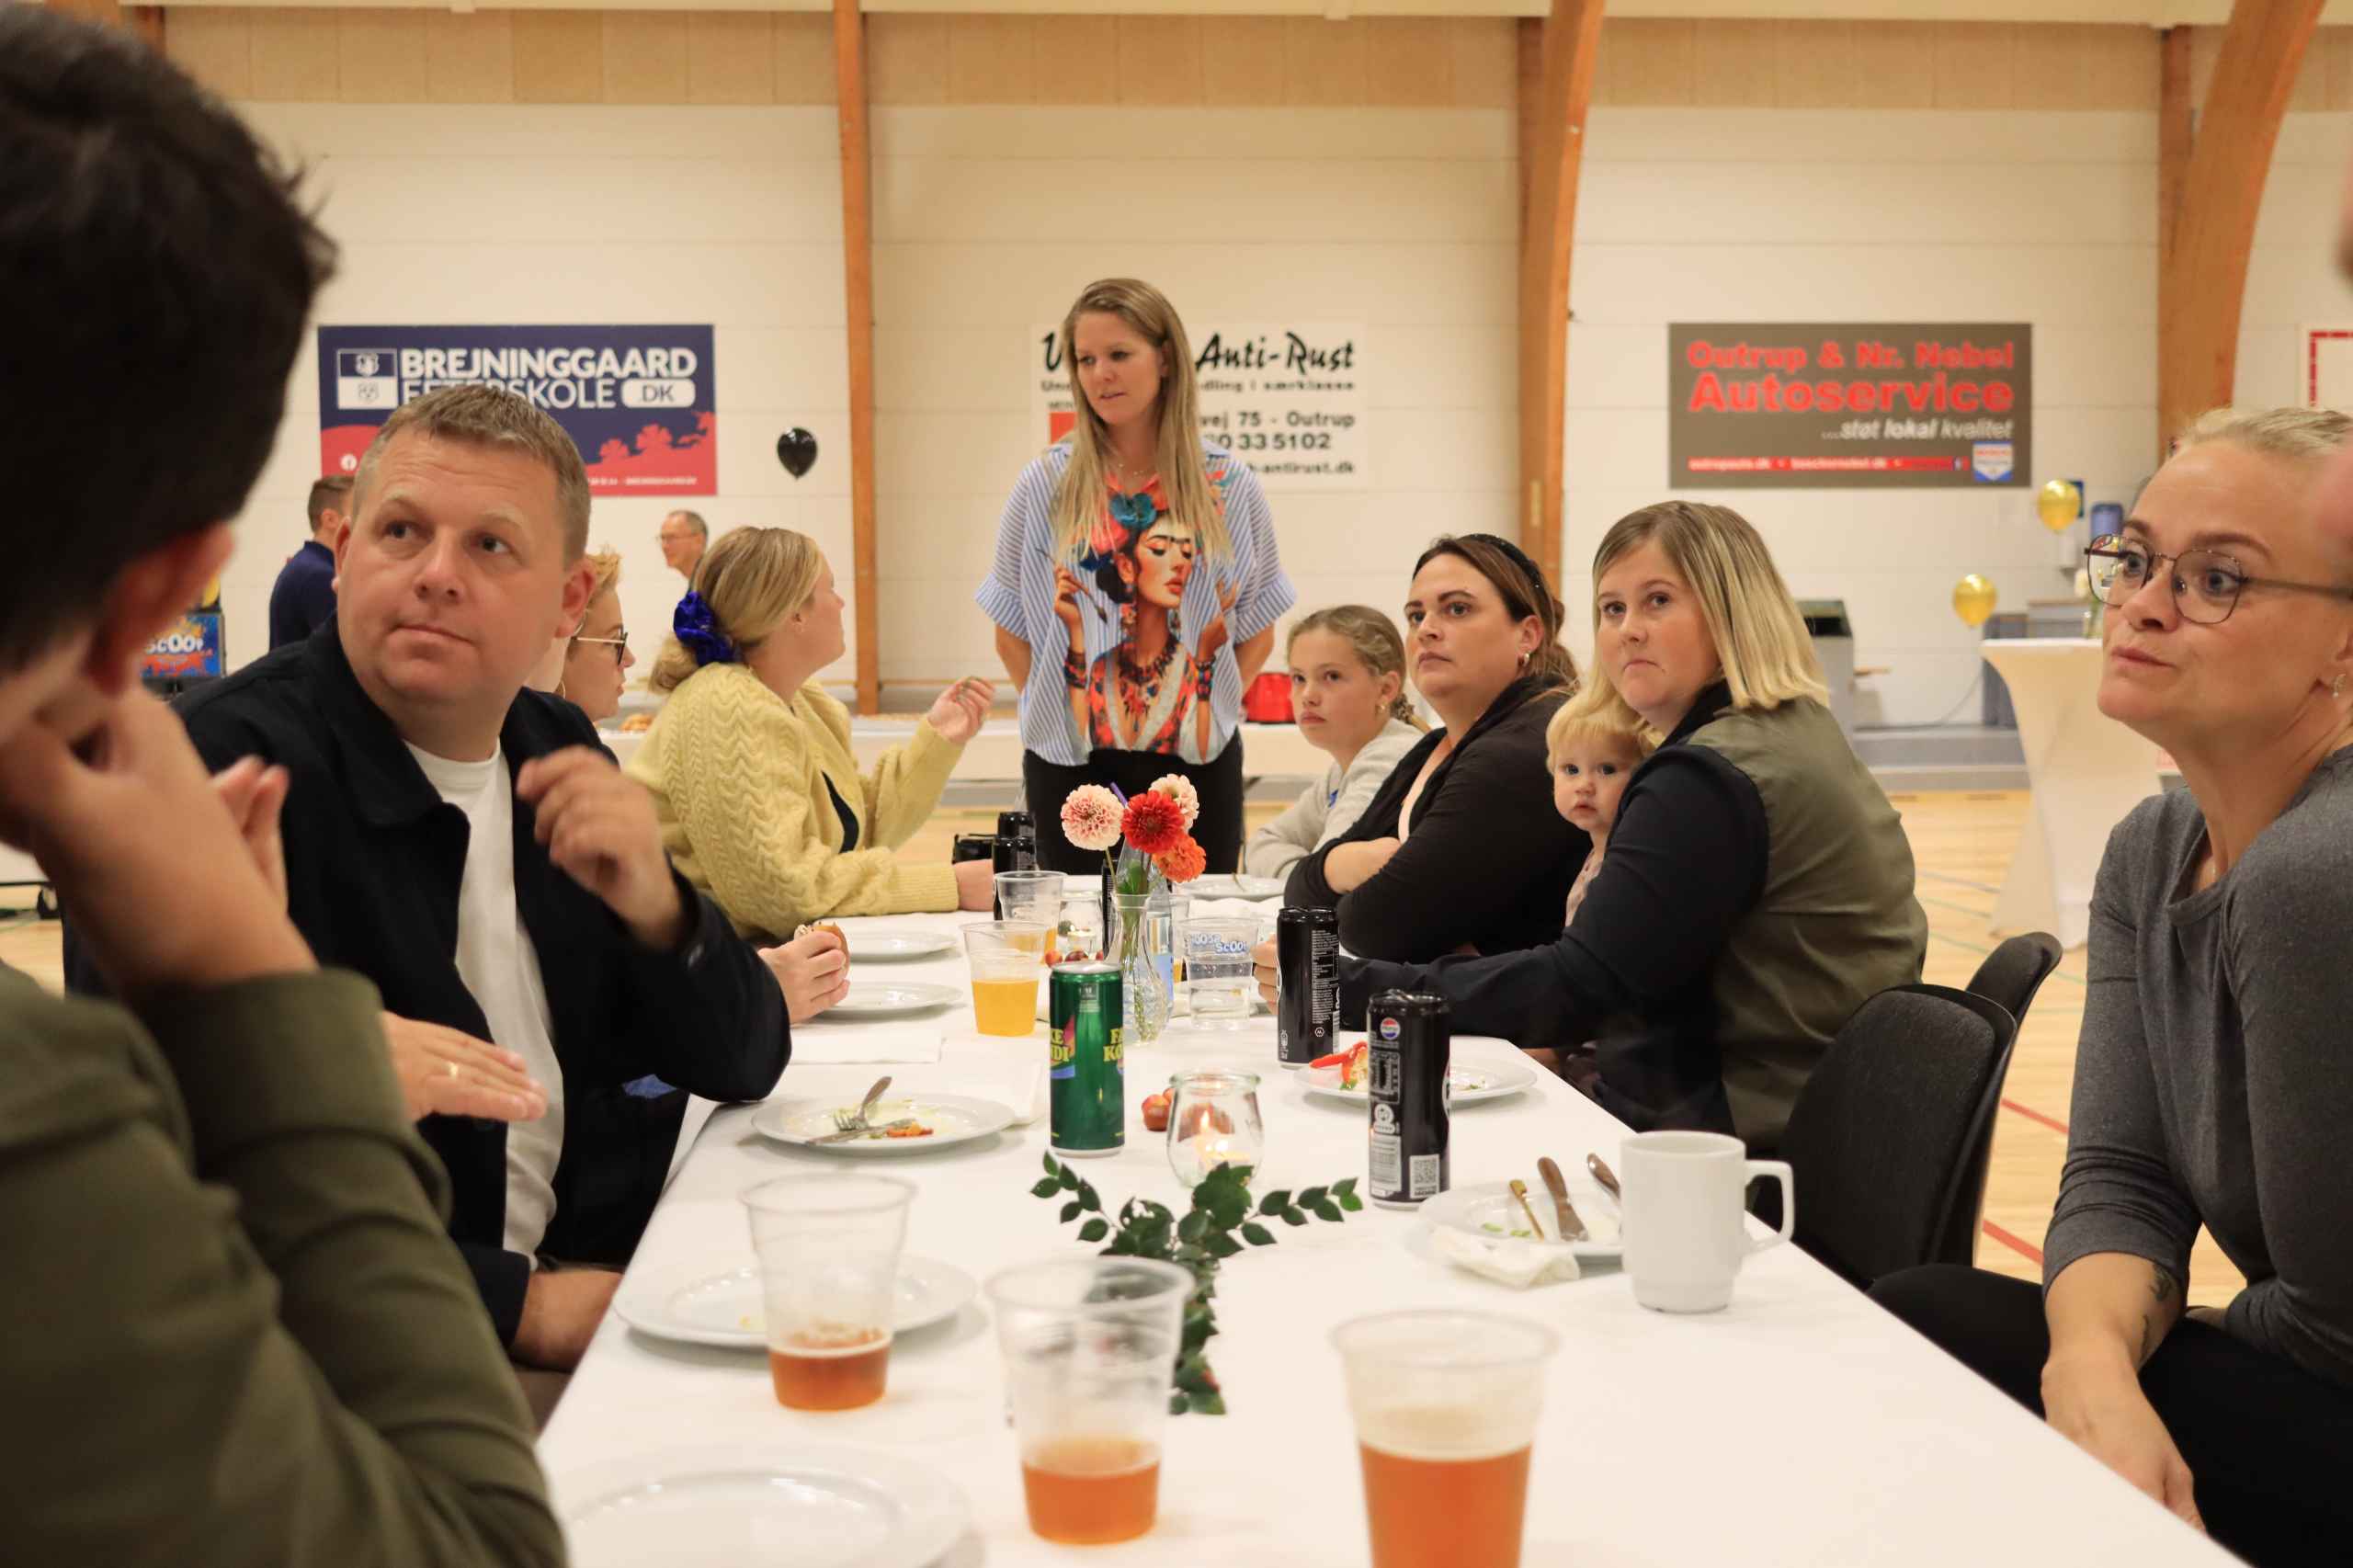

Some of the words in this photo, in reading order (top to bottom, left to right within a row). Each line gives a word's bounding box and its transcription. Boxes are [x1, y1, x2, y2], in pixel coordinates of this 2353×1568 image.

[400, 347, 698, 380] BREJNINGGAARD
[1196, 332, 1354, 375] Anti-Rust
[1688, 341, 1808, 374] Outrup
[1818, 341, 1845, 369] &
[1856, 342, 1904, 369] Nr.
[1689, 371, 2015, 413] Autoservice
[1238, 411, 1262, 426] 75
[1286, 411, 1356, 429] Outrup
[1883, 418, 1938, 439] lokal
[1940, 419, 2014, 439] kvalitet
